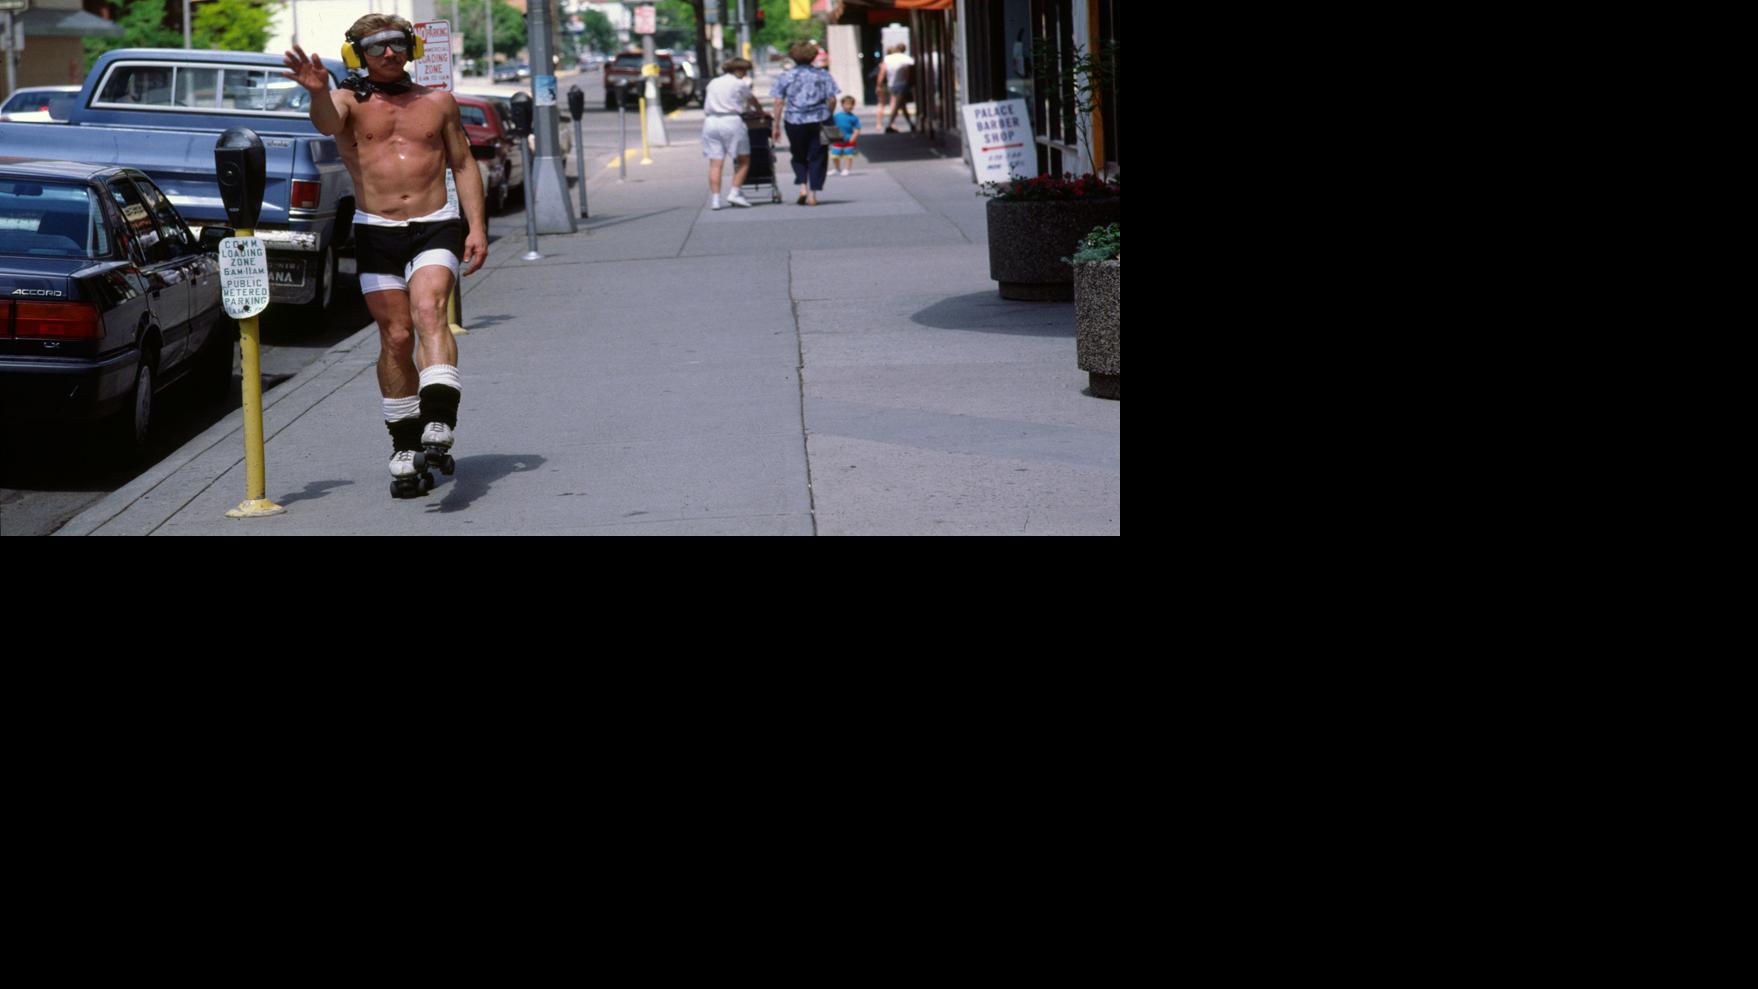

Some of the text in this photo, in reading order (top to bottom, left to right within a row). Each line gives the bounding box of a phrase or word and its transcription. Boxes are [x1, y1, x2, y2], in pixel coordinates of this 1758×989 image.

[425, 64, 442, 74] ZONE
[974, 104, 1014, 118] PALACE
[976, 117, 1020, 131] BARBER
[984, 130, 1014, 144] SHOP
[224, 239, 257, 249] COMM
[222, 248, 263, 258] LOADING
[231, 258, 256, 267] ZONE
[226, 279, 262, 289] PUBLIC
[11, 288, 62, 297] ACCORD
[223, 287, 267, 297] METERED
[224, 296, 267, 306] PARKING
